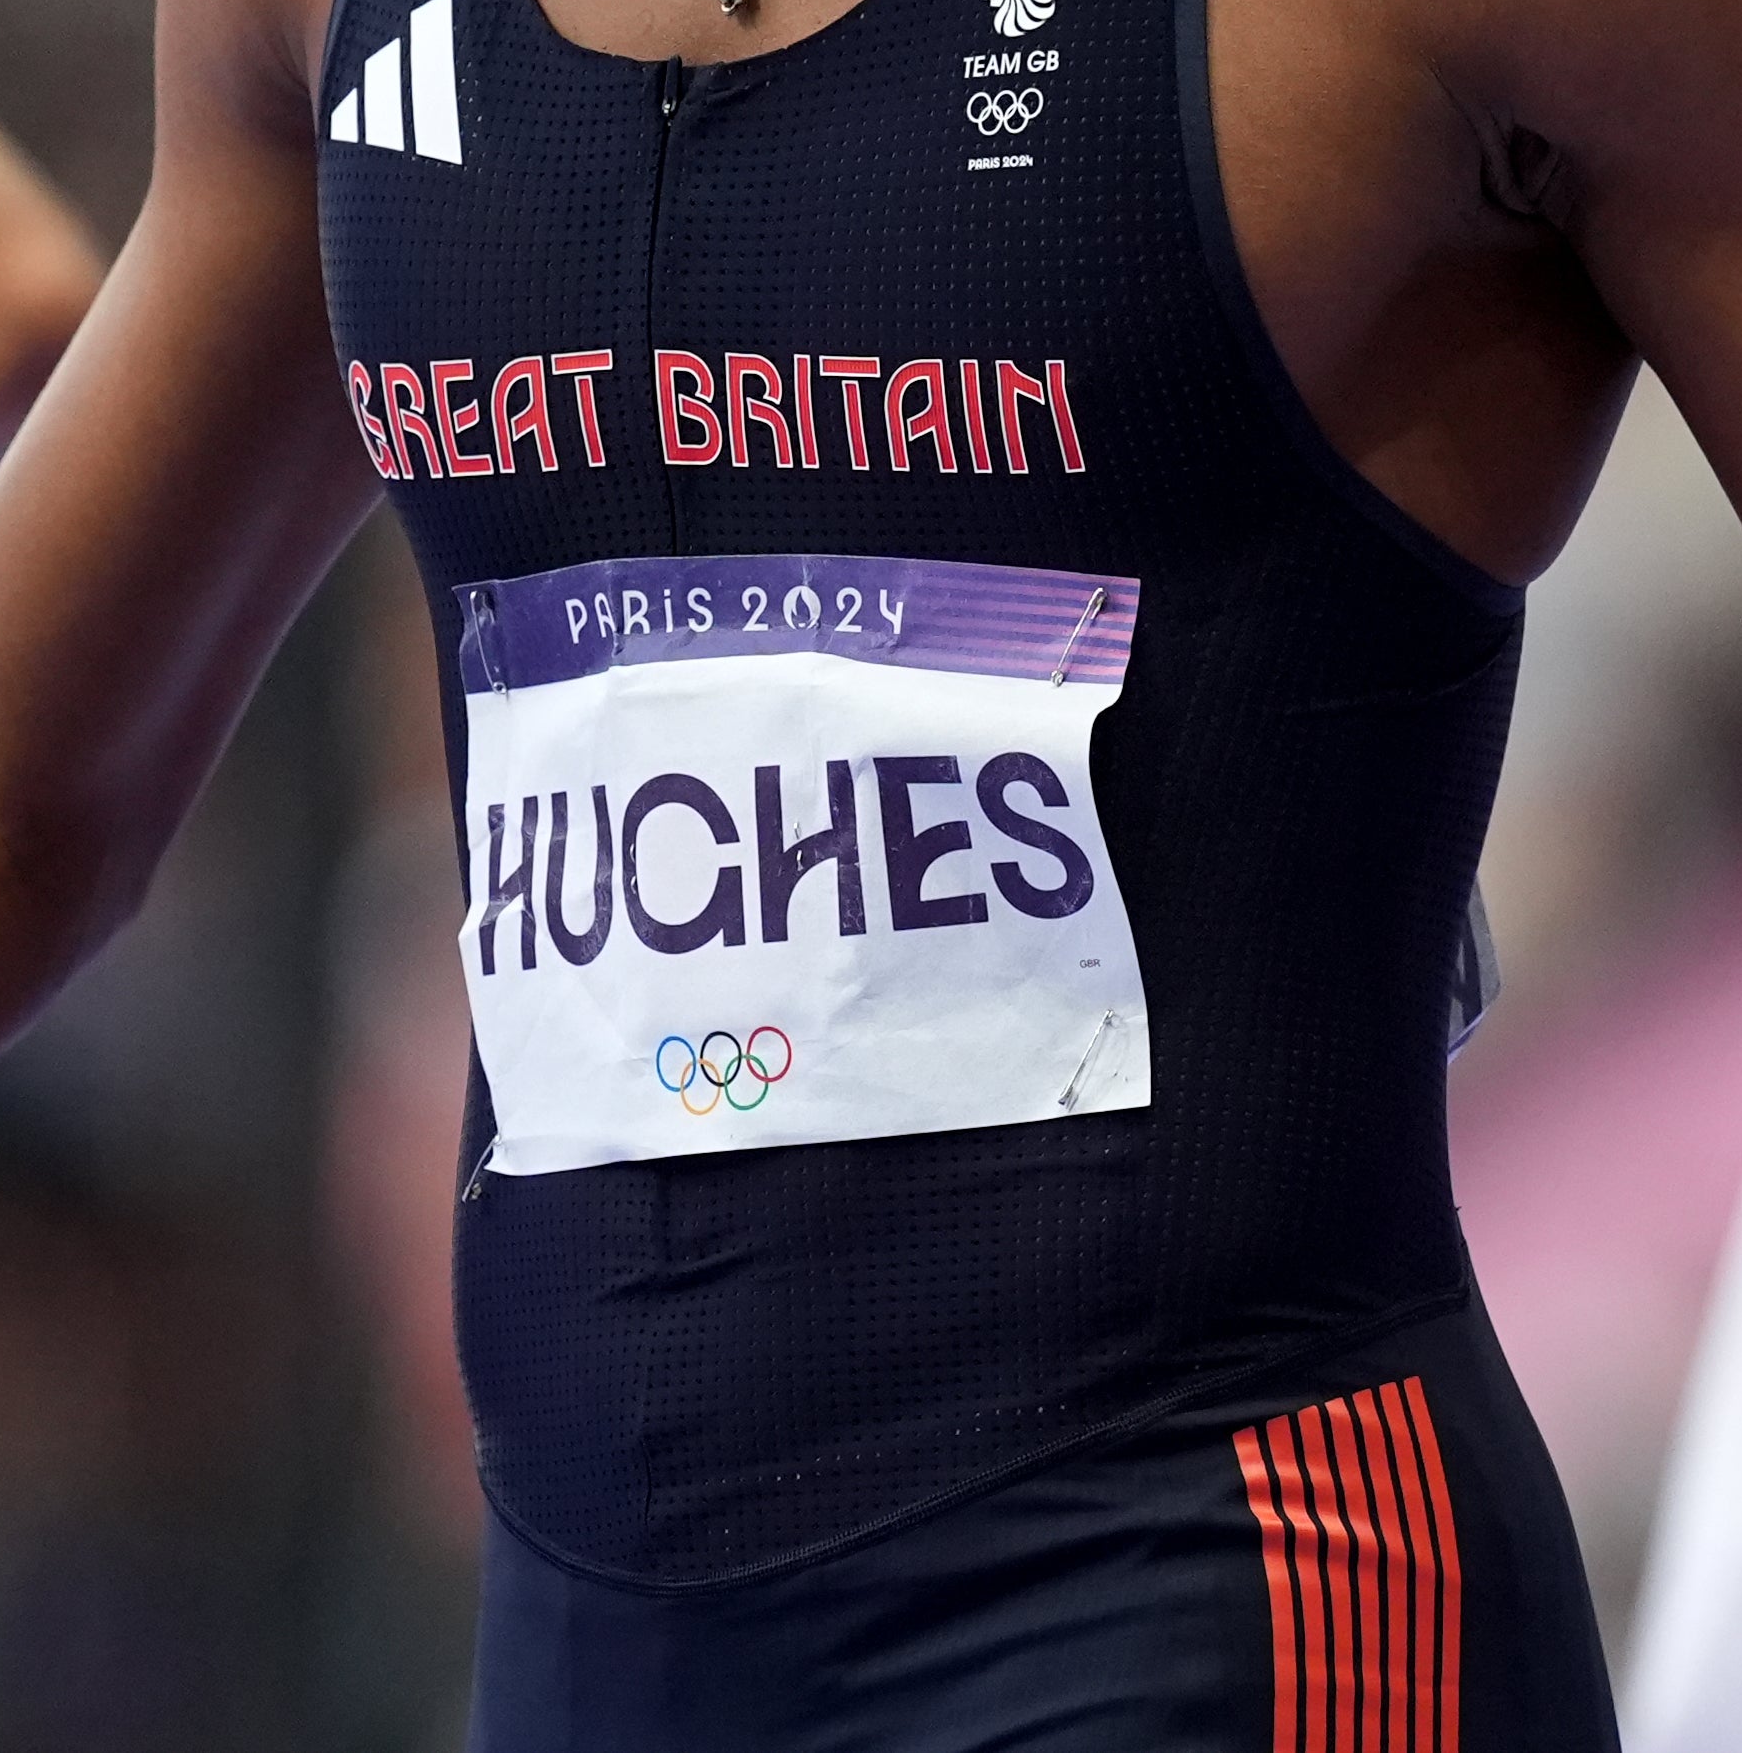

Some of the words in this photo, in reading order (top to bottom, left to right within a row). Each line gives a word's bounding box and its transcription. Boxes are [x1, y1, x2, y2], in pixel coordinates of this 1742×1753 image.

[963, 51, 1022, 79] TEAM
[1026, 49, 1060, 73] GB
[1002, 153, 1034, 168] 2024
[348, 348, 613, 481] GREAT
[653, 348, 1086, 475] BRITAIN
[741, 585, 905, 635] 2024
[480, 751, 1095, 976] HUGHES
[1079, 958, 1101, 969] GBR
